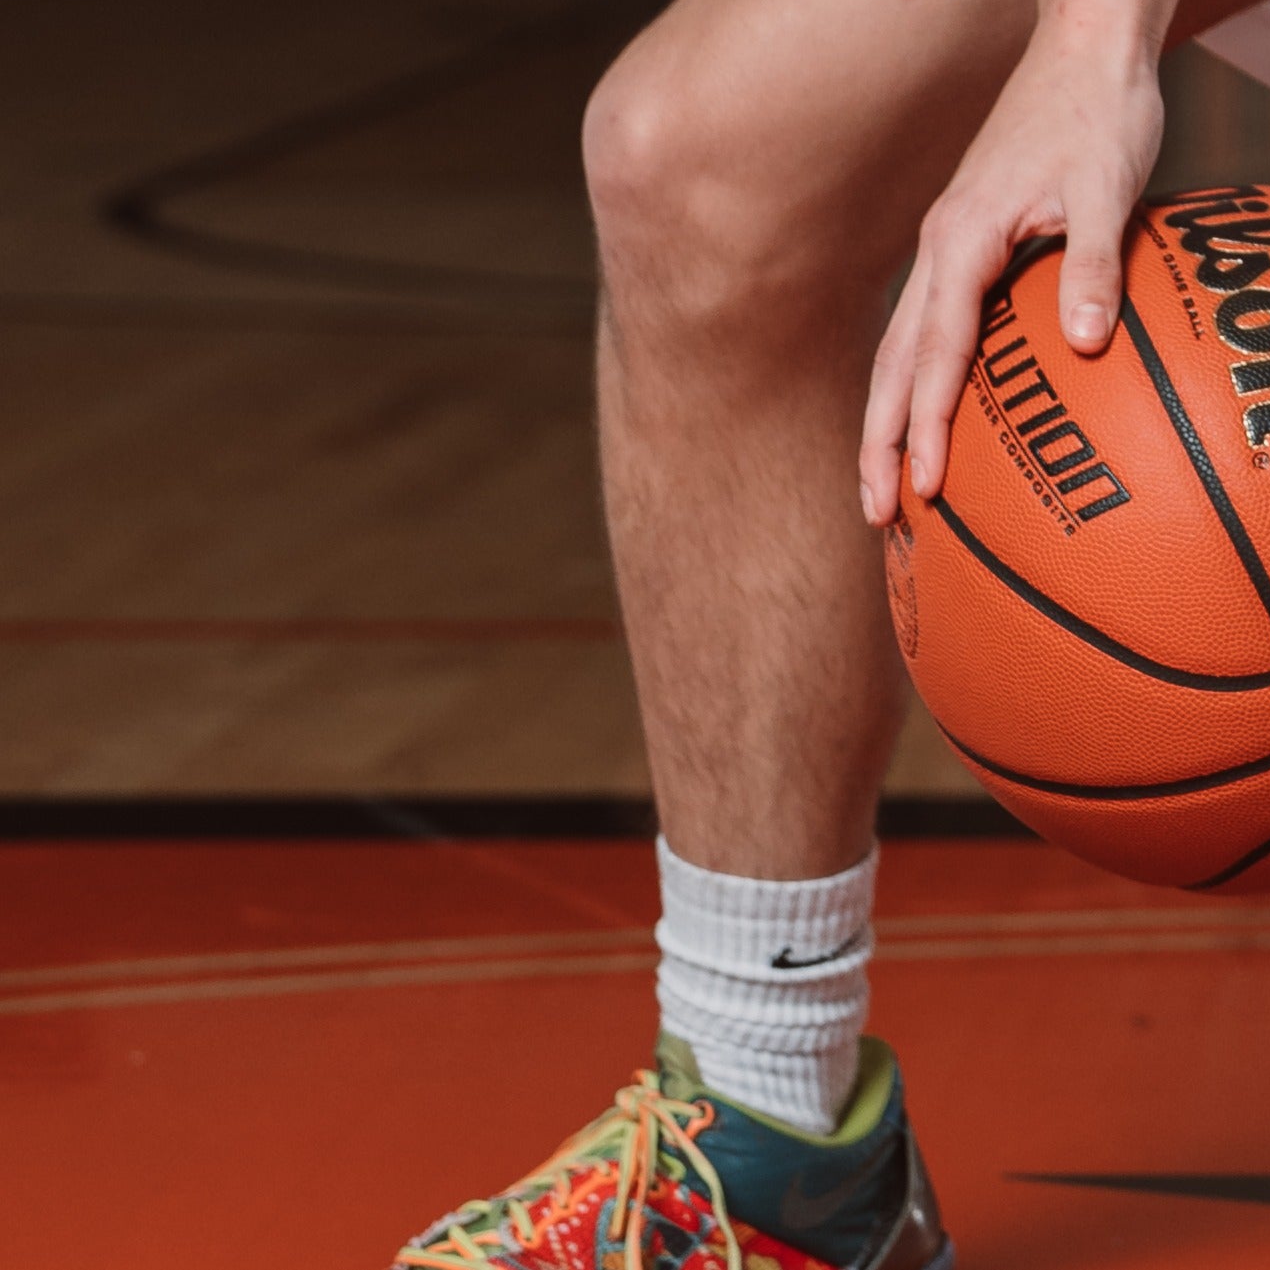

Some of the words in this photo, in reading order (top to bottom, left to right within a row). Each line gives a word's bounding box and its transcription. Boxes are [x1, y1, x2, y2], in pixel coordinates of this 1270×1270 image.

[1163, 253, 1188, 292] GAME
[1182, 297, 1204, 340] BALL
[977, 291, 1131, 522] OLUTION
[999, 431, 1076, 537] COMPOSITE
